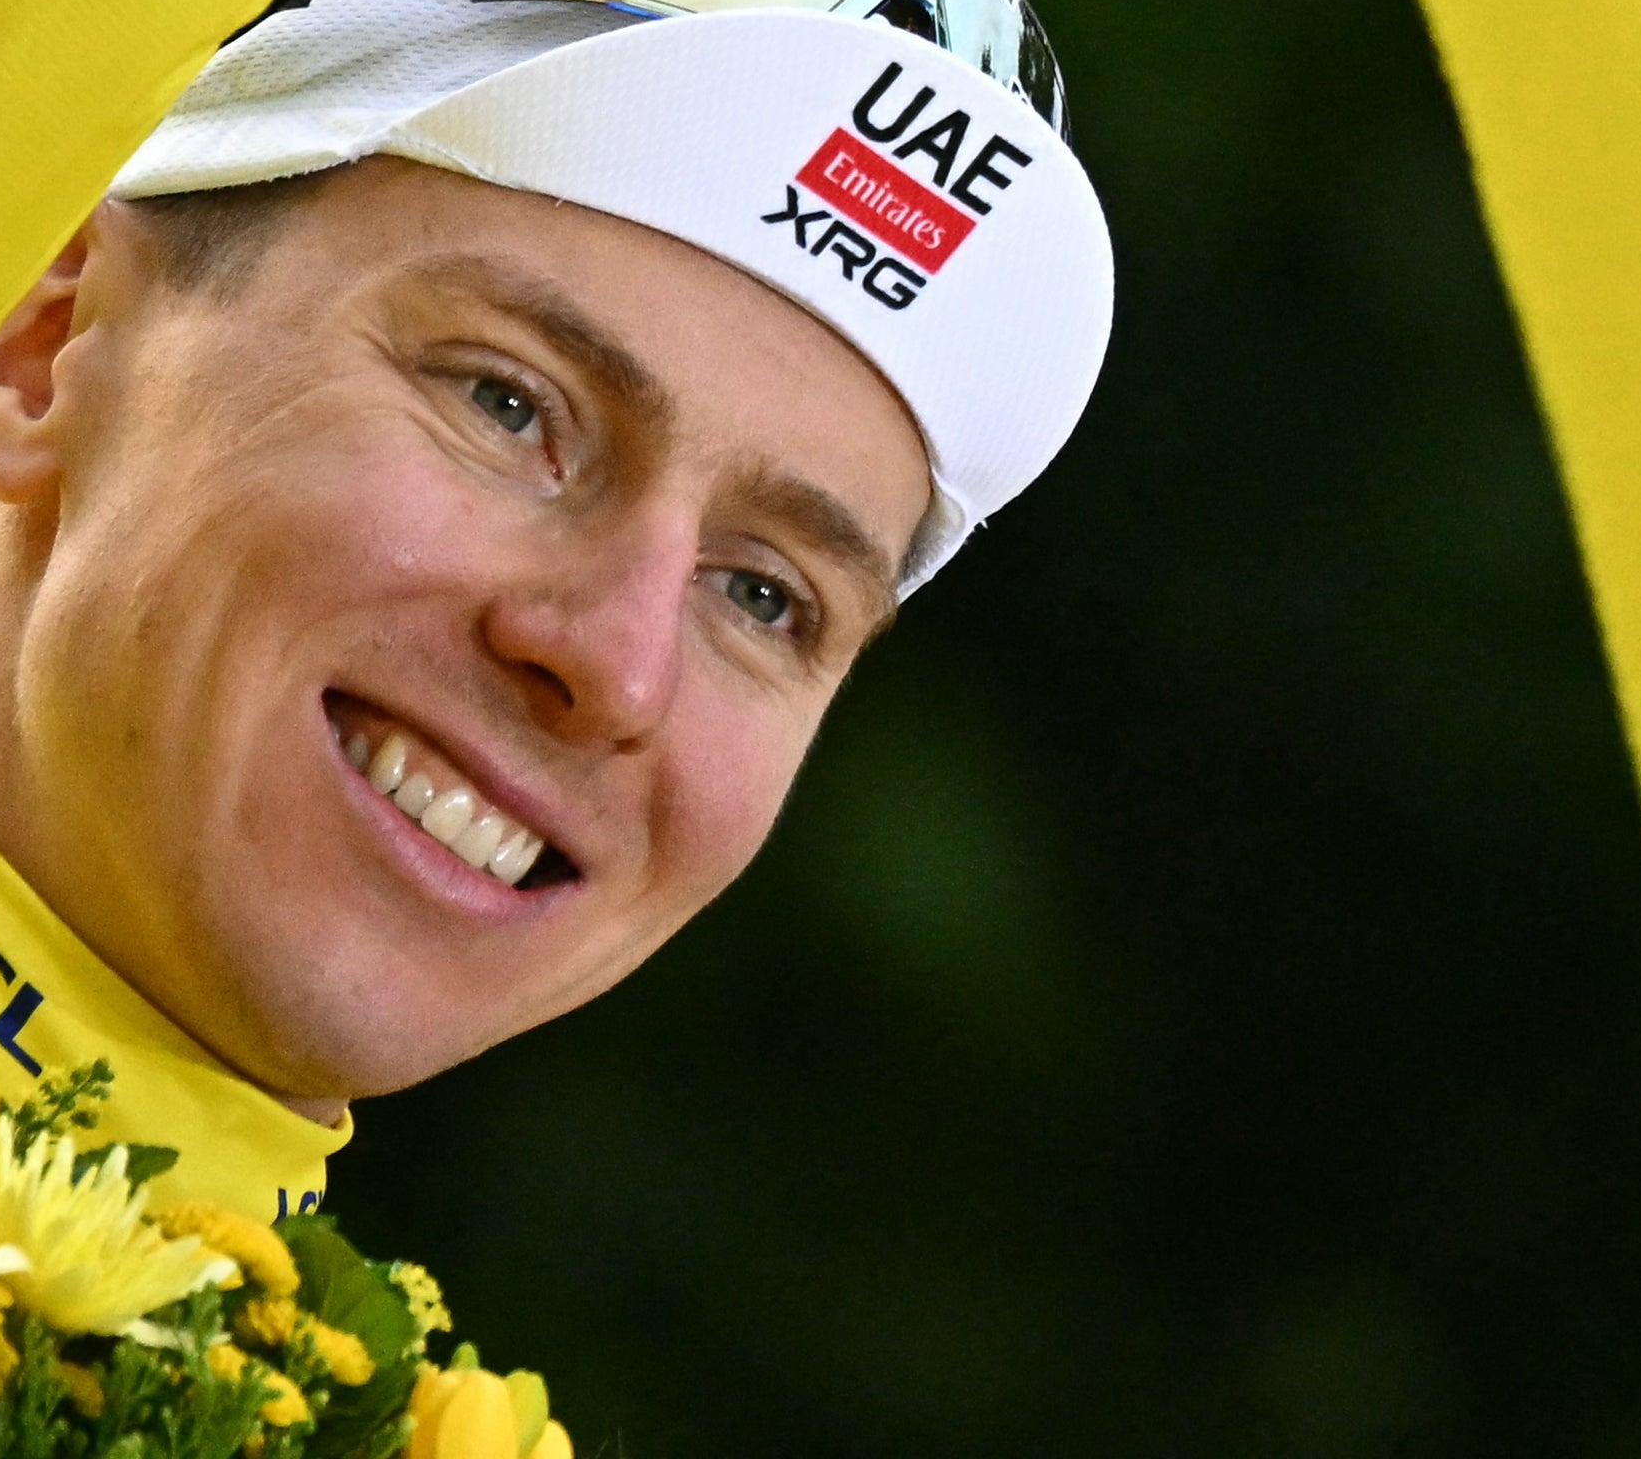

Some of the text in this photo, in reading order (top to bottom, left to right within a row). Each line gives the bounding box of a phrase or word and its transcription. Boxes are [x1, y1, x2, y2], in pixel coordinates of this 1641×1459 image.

[823, 150, 947, 250] Emirates
[852, 61, 1033, 216] UAE
[760, 184, 927, 310] XRG
